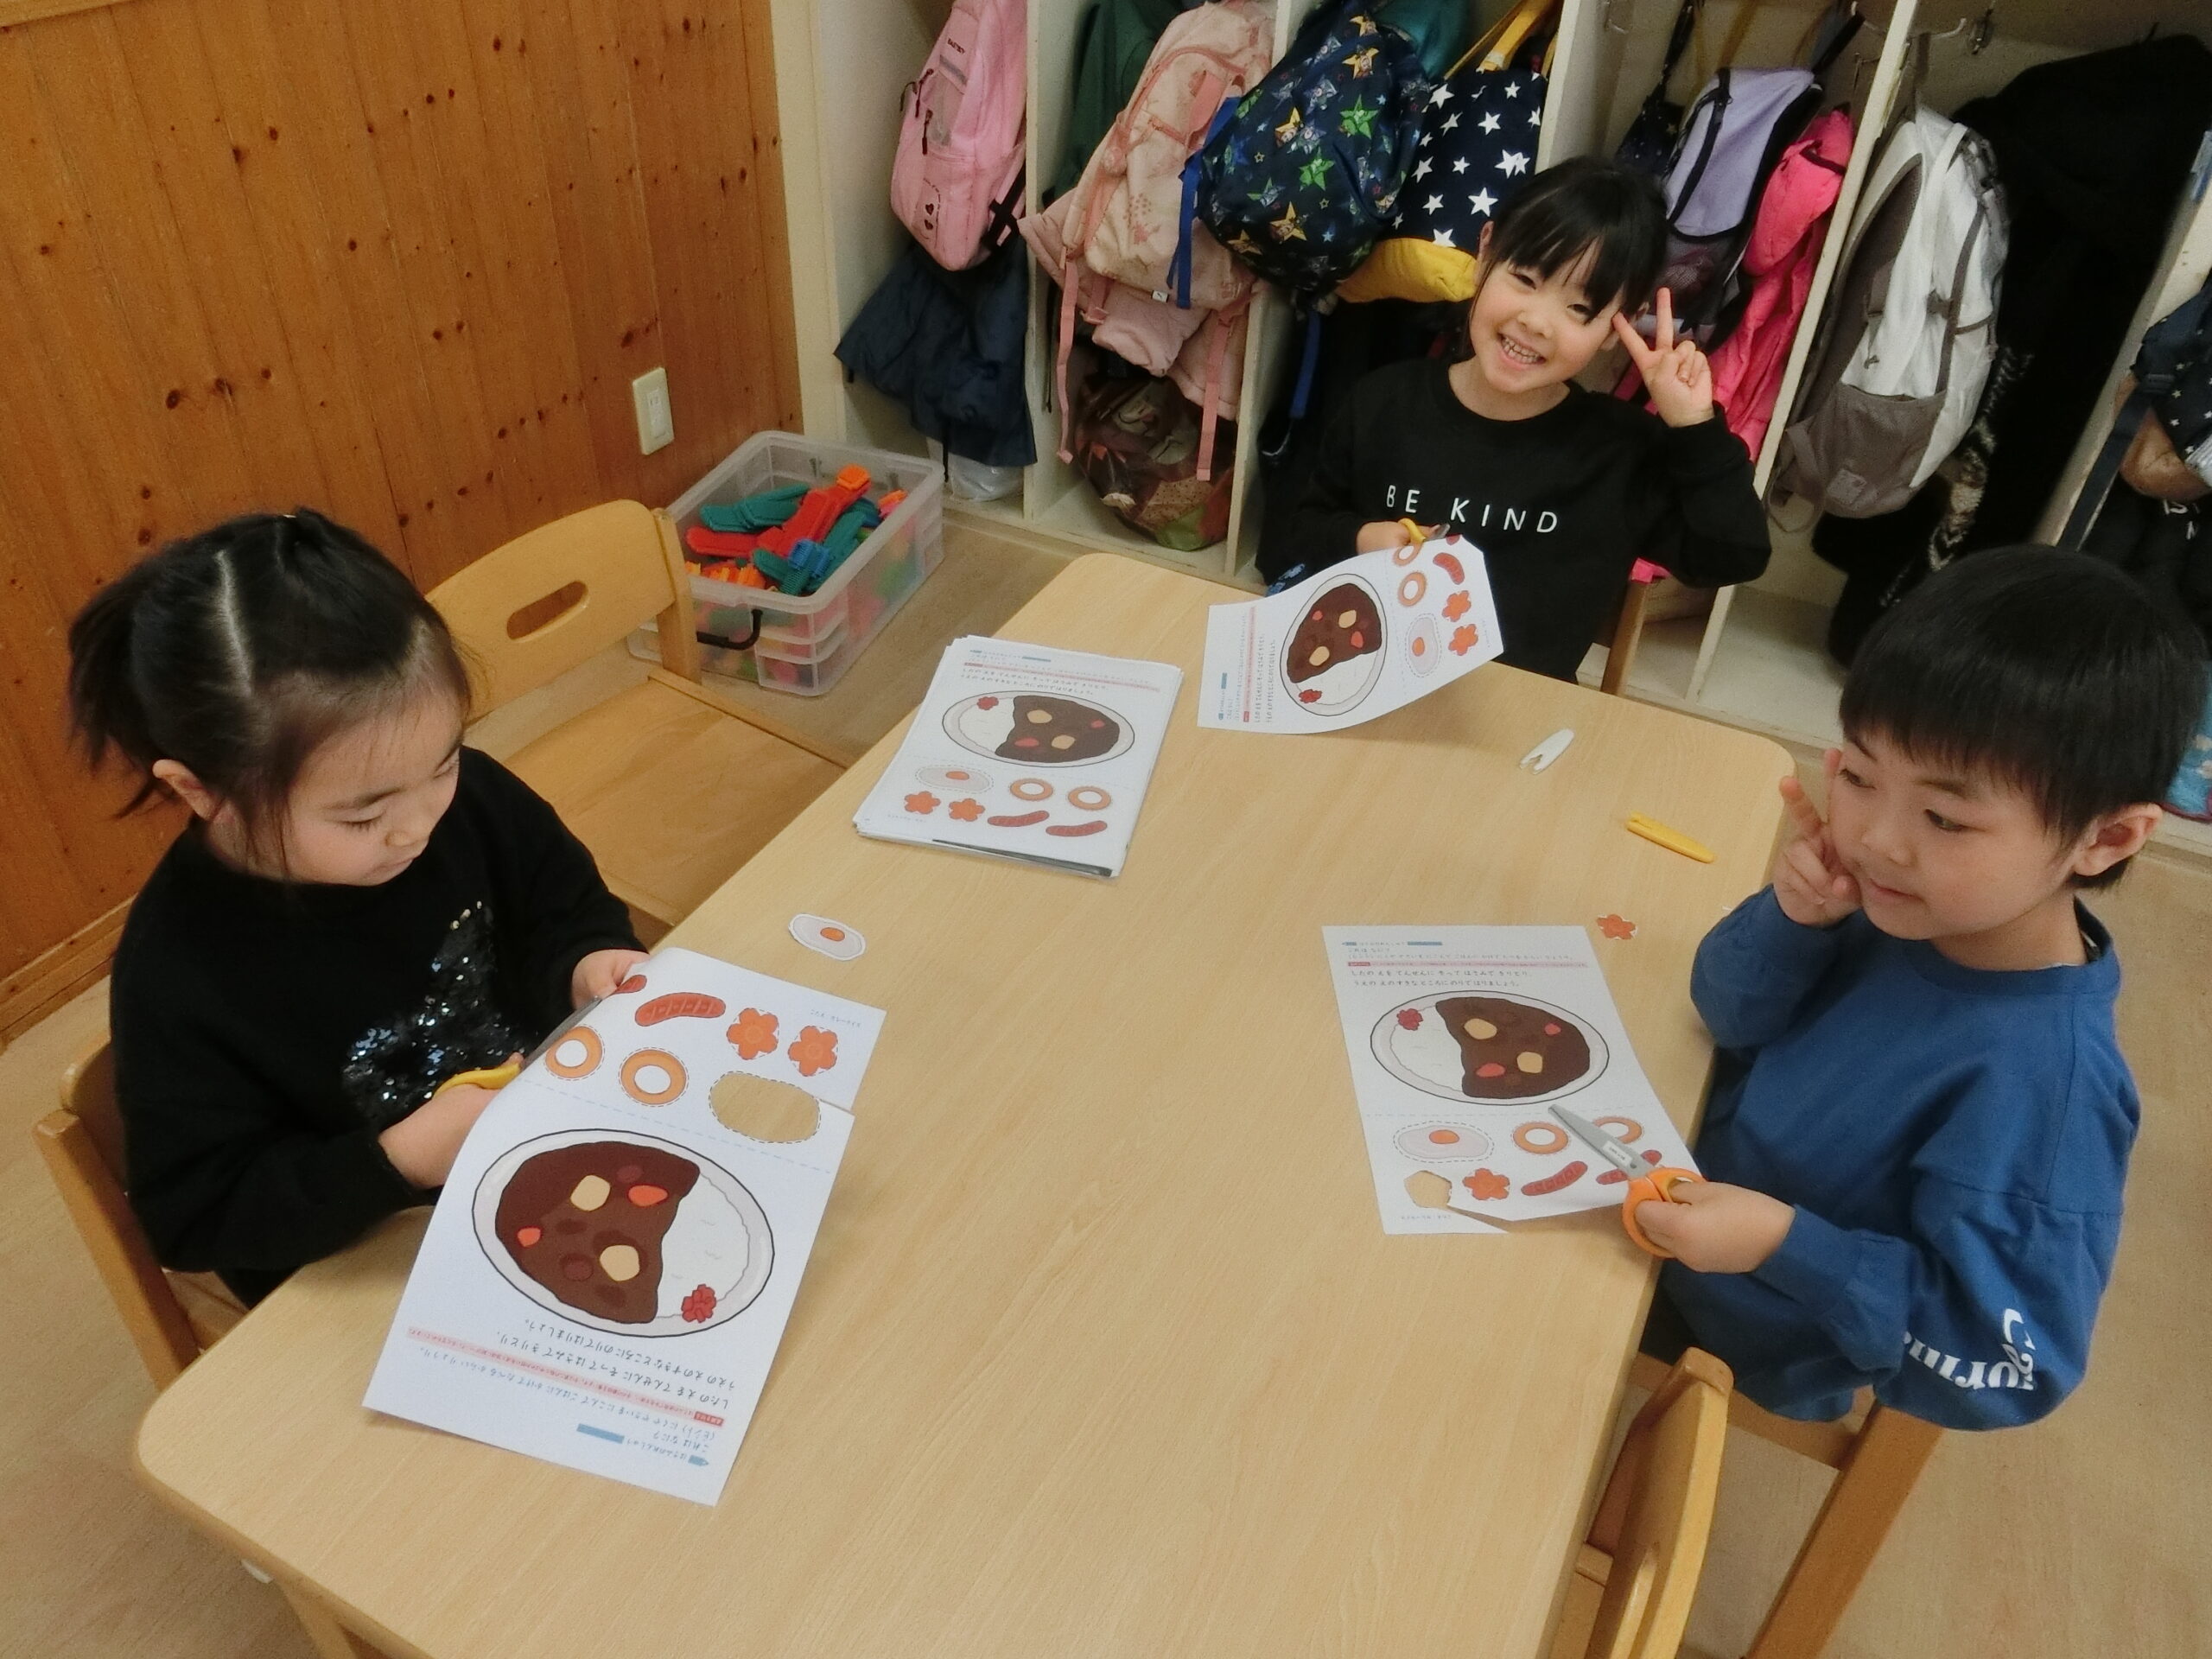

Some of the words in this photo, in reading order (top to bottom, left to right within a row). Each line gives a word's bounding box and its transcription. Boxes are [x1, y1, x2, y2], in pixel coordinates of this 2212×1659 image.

[1386, 484, 1421, 513] BE
[1450, 497, 1558, 533] KIND
[541, 1346, 587, 1368] はさみで
[588, 1359, 619, 1378] そって
[622, 1370, 671, 1393] てんせんに
[676, 1385, 697, 1401] えを
[698, 1393, 729, 1410] したの
